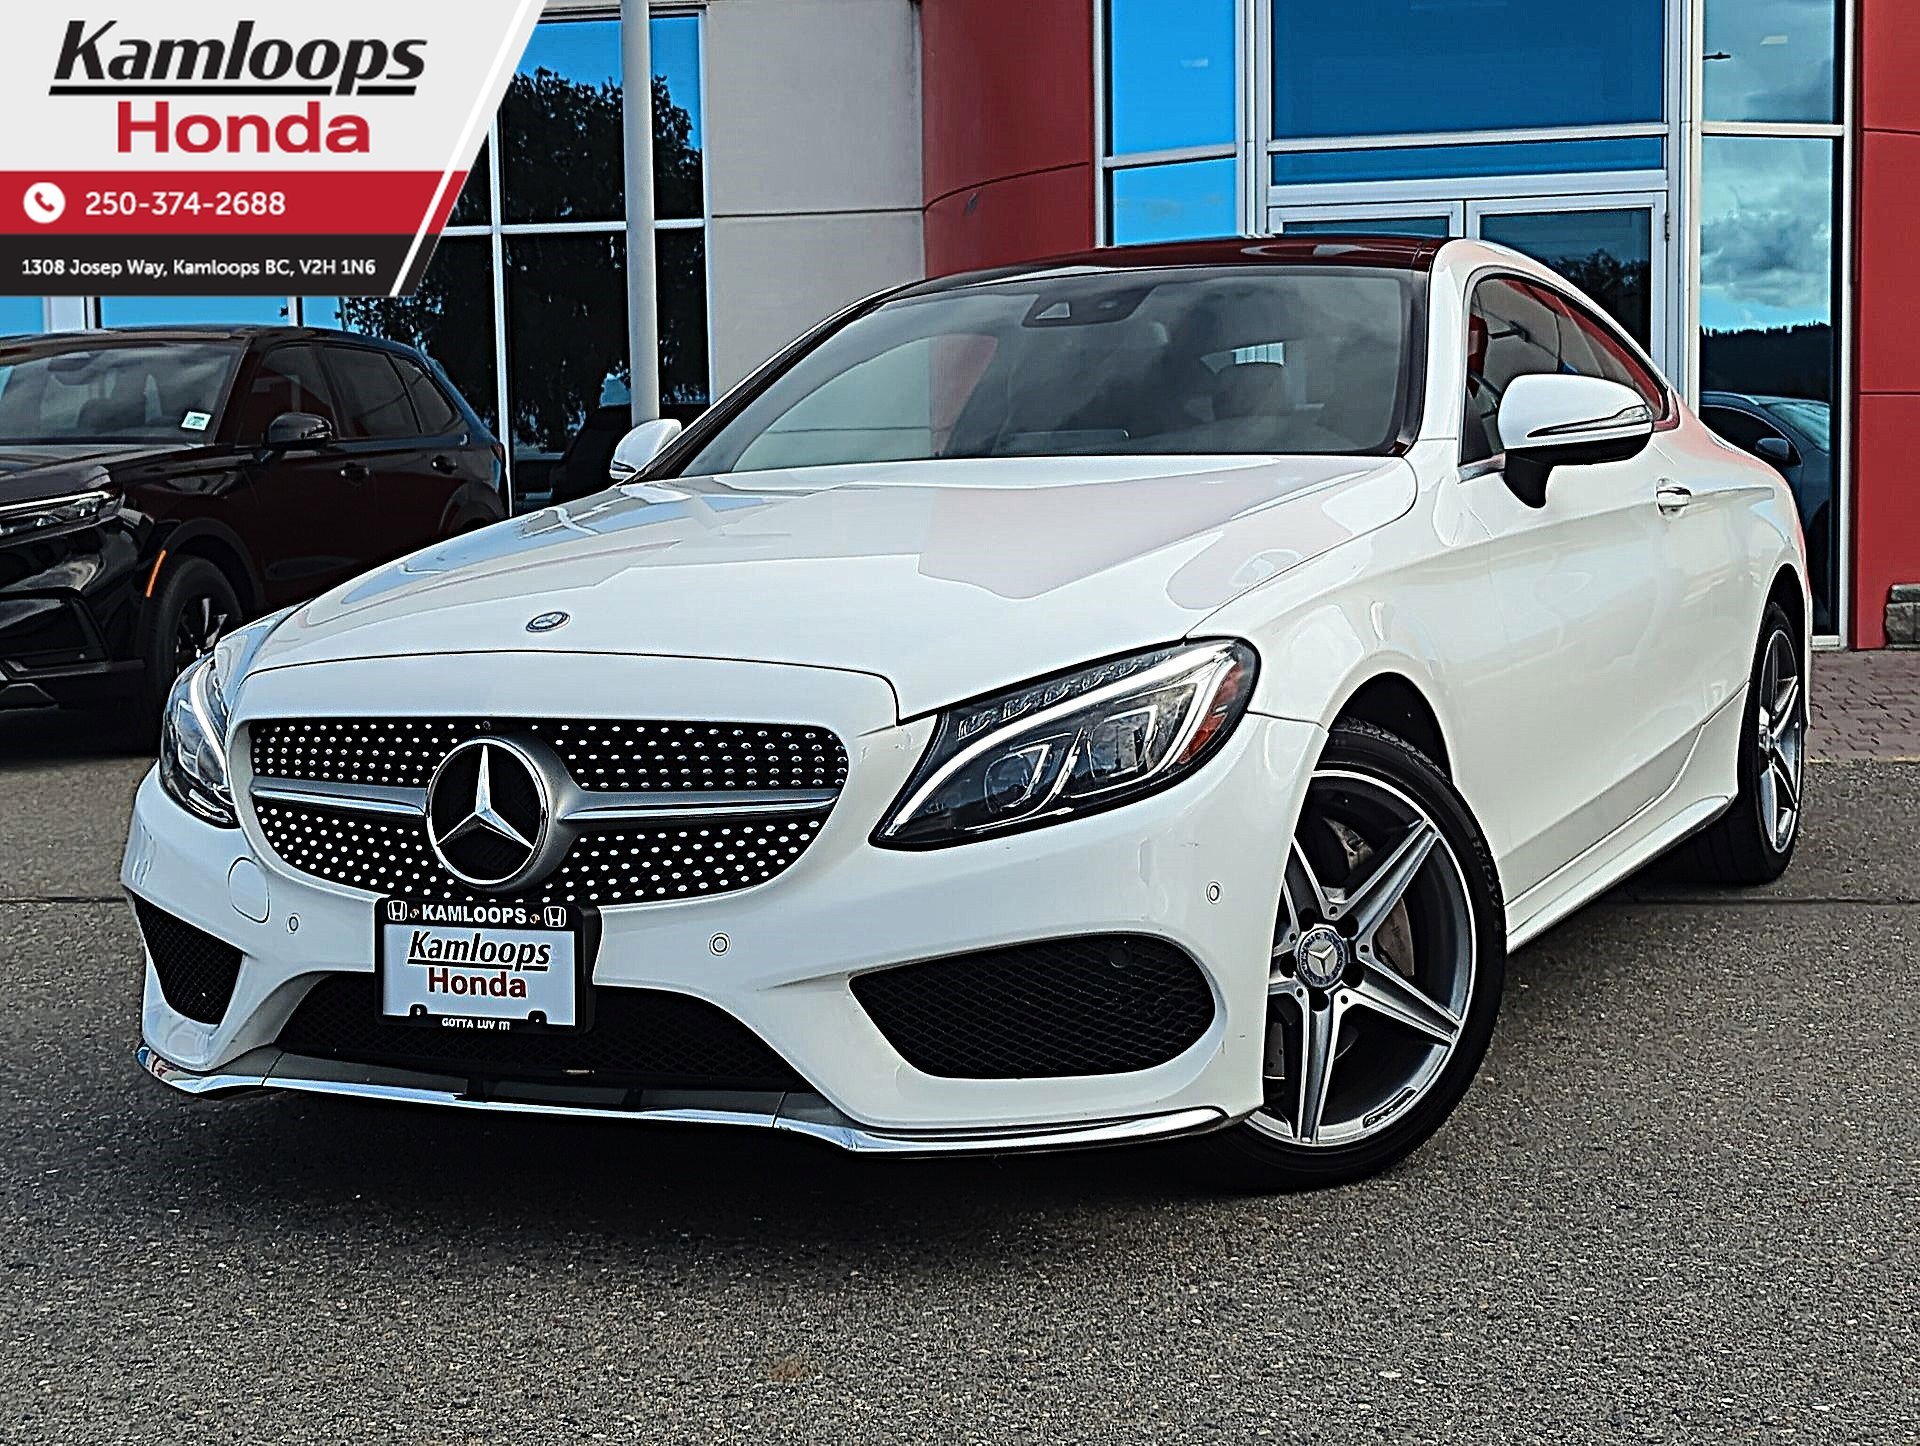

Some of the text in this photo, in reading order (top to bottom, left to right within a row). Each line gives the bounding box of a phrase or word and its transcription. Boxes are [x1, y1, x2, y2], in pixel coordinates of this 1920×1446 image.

[422, 904, 527, 924] KAMLOOPS
[409, 930, 551, 971] Kamloops
[427, 967, 527, 998] Honda
[441, 1017, 474, 1029] GOTTA
[477, 1019, 496, 1030] LUV
